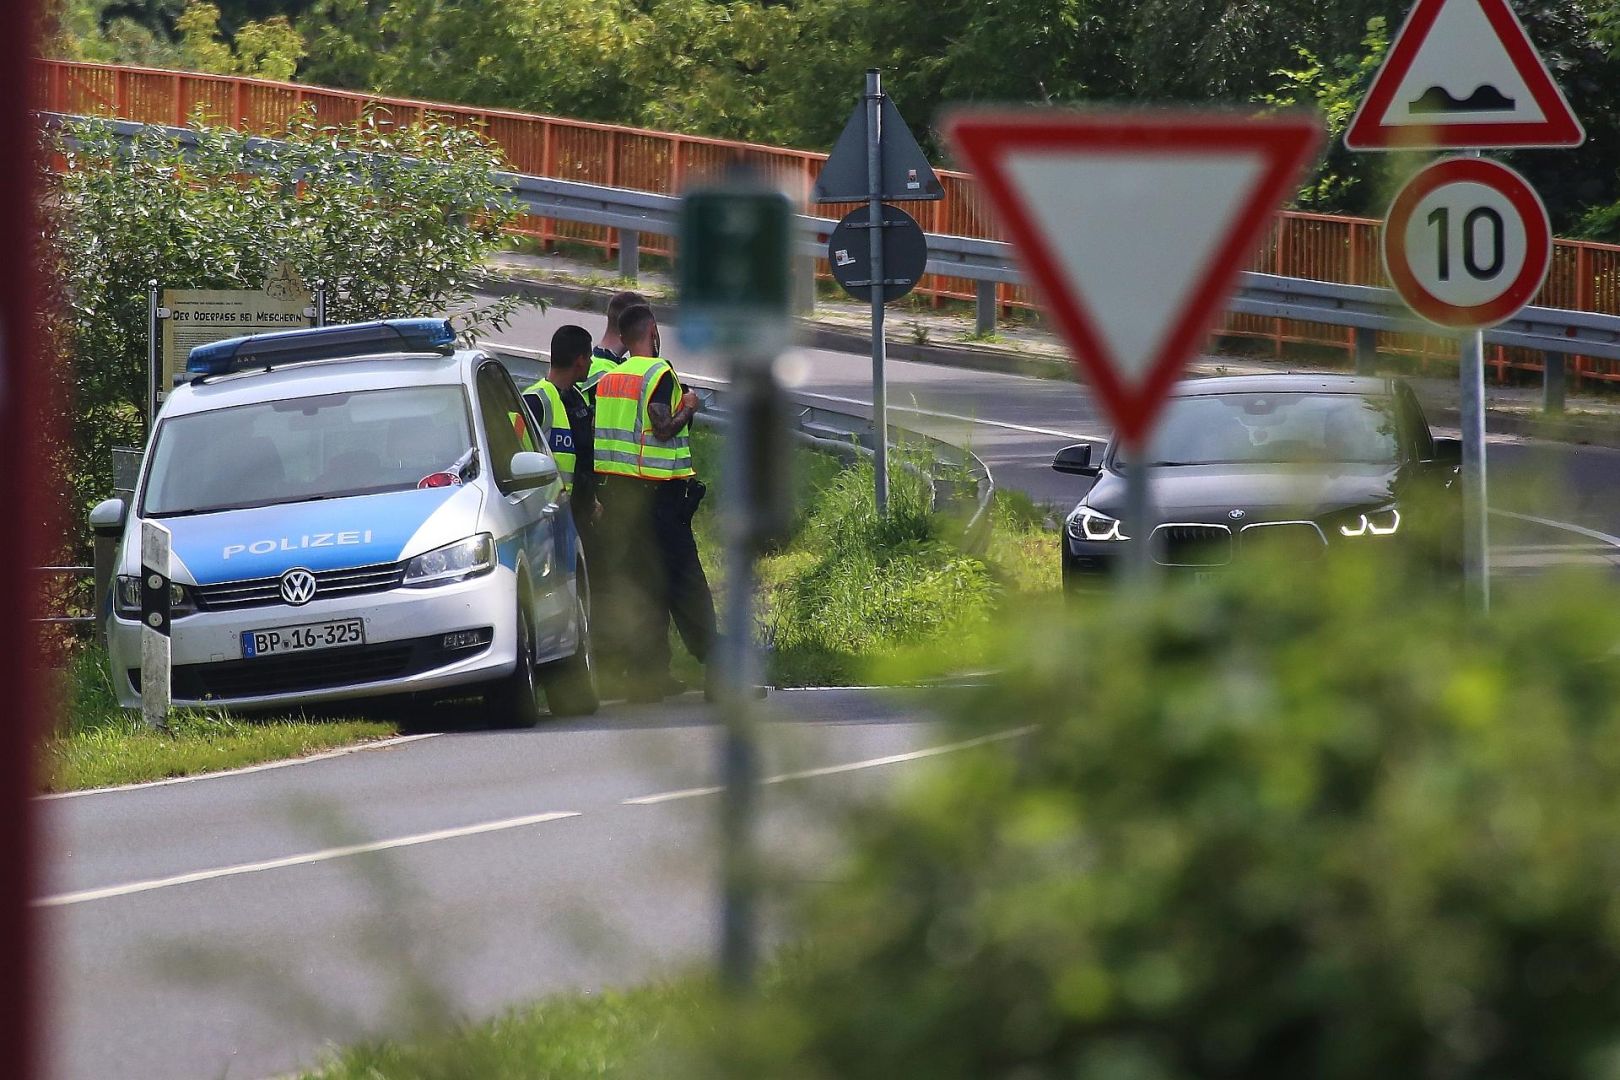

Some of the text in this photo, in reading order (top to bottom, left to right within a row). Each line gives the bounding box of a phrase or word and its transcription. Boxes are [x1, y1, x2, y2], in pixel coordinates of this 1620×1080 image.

[1427, 206, 1504, 281] 10
[193, 311, 236, 322] ODERPASS
[240, 313, 252, 322] BEI
[256, 311, 302, 322] MESCHERIN
[555, 434, 575, 448] PO
[223, 529, 373, 560] POLIZEI
